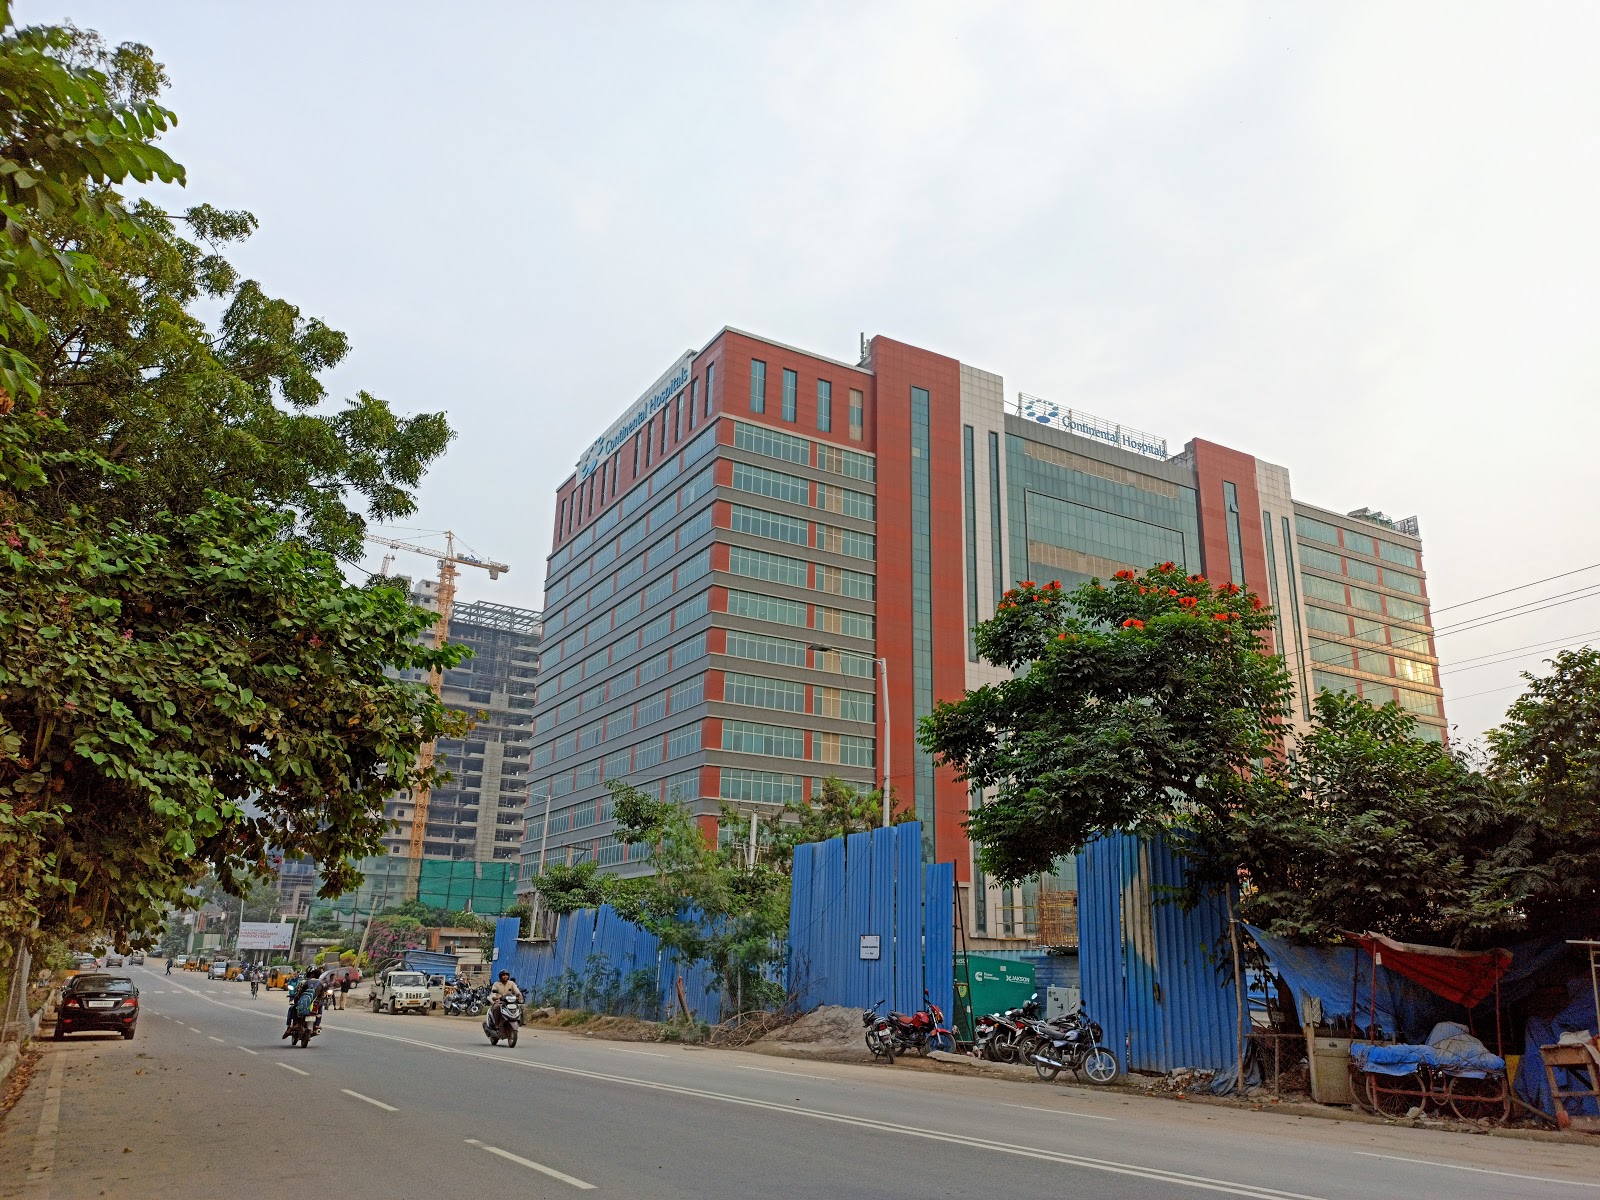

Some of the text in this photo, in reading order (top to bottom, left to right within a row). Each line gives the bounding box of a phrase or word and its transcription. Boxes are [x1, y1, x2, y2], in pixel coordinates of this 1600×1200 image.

[605, 367, 689, 455] Continental Hospitals
[1062, 415, 1168, 458] Continental Hospitals
